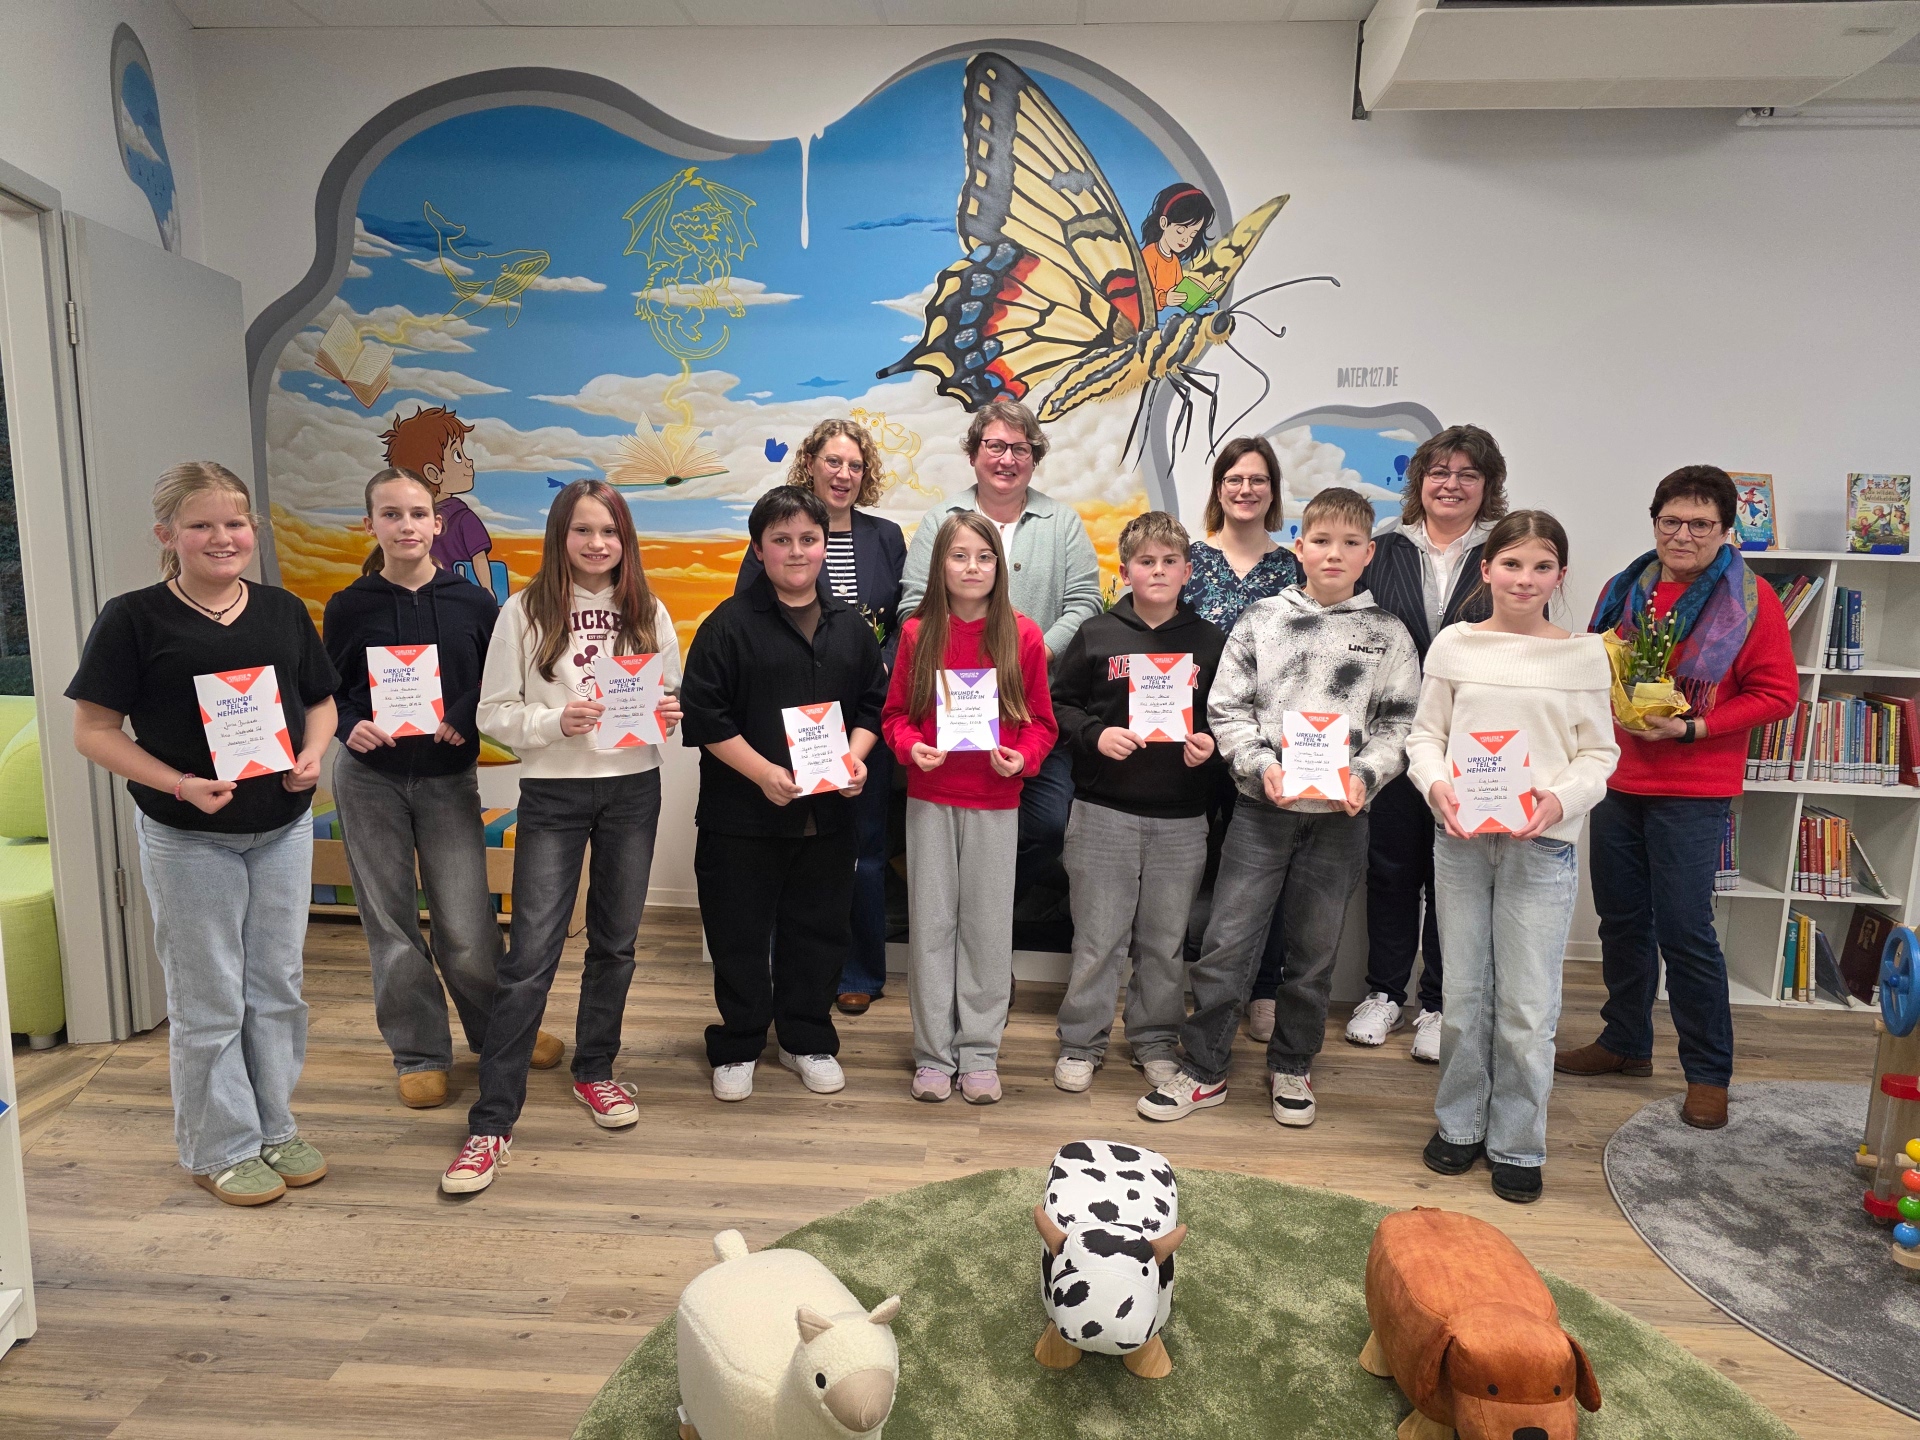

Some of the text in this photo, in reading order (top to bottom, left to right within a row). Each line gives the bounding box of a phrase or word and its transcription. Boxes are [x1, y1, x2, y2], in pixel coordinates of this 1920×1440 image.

[1337, 366, 1399, 388] DATER127.DE
[572, 610, 623, 632] ICKE
[216, 695, 252, 706] URKUNDE
